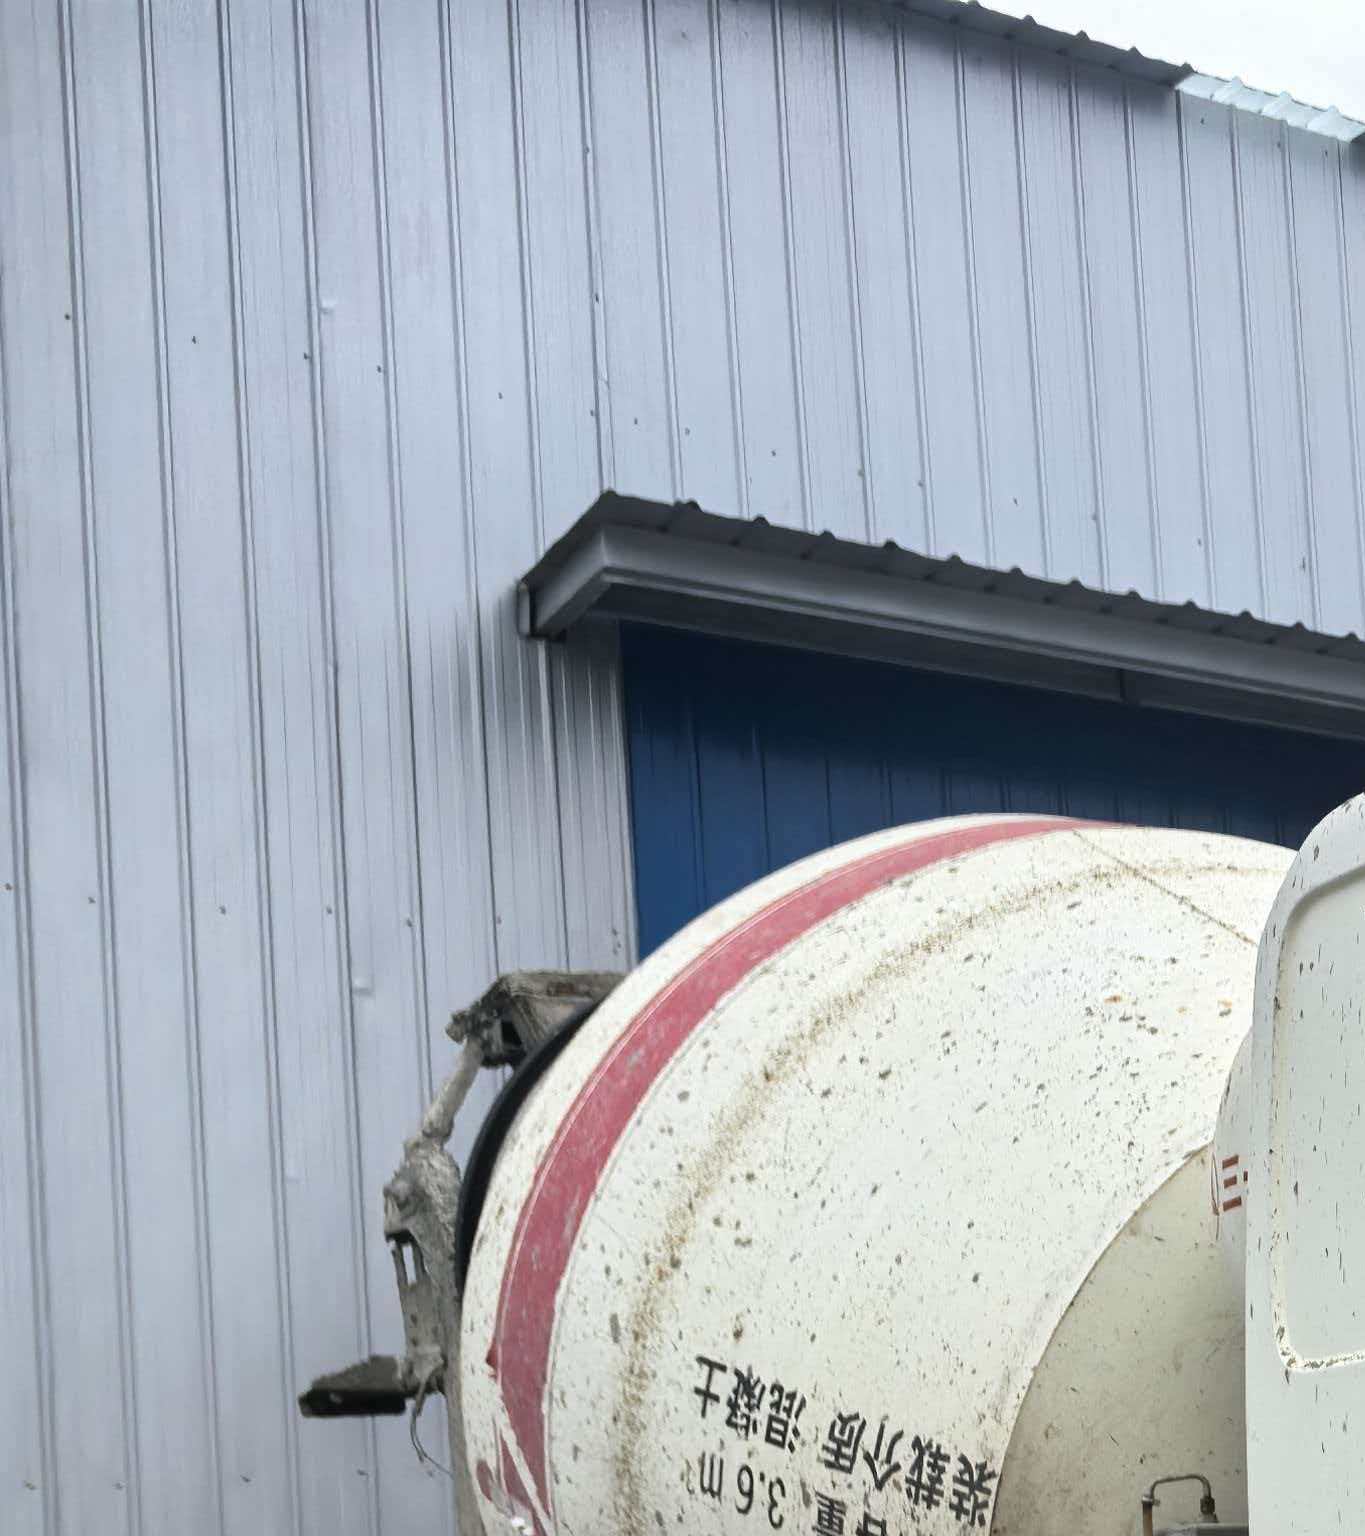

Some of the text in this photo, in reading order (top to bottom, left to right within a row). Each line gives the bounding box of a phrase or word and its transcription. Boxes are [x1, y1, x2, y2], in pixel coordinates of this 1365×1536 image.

[693, 1355, 999, 1528] 装载介质 混凝土
